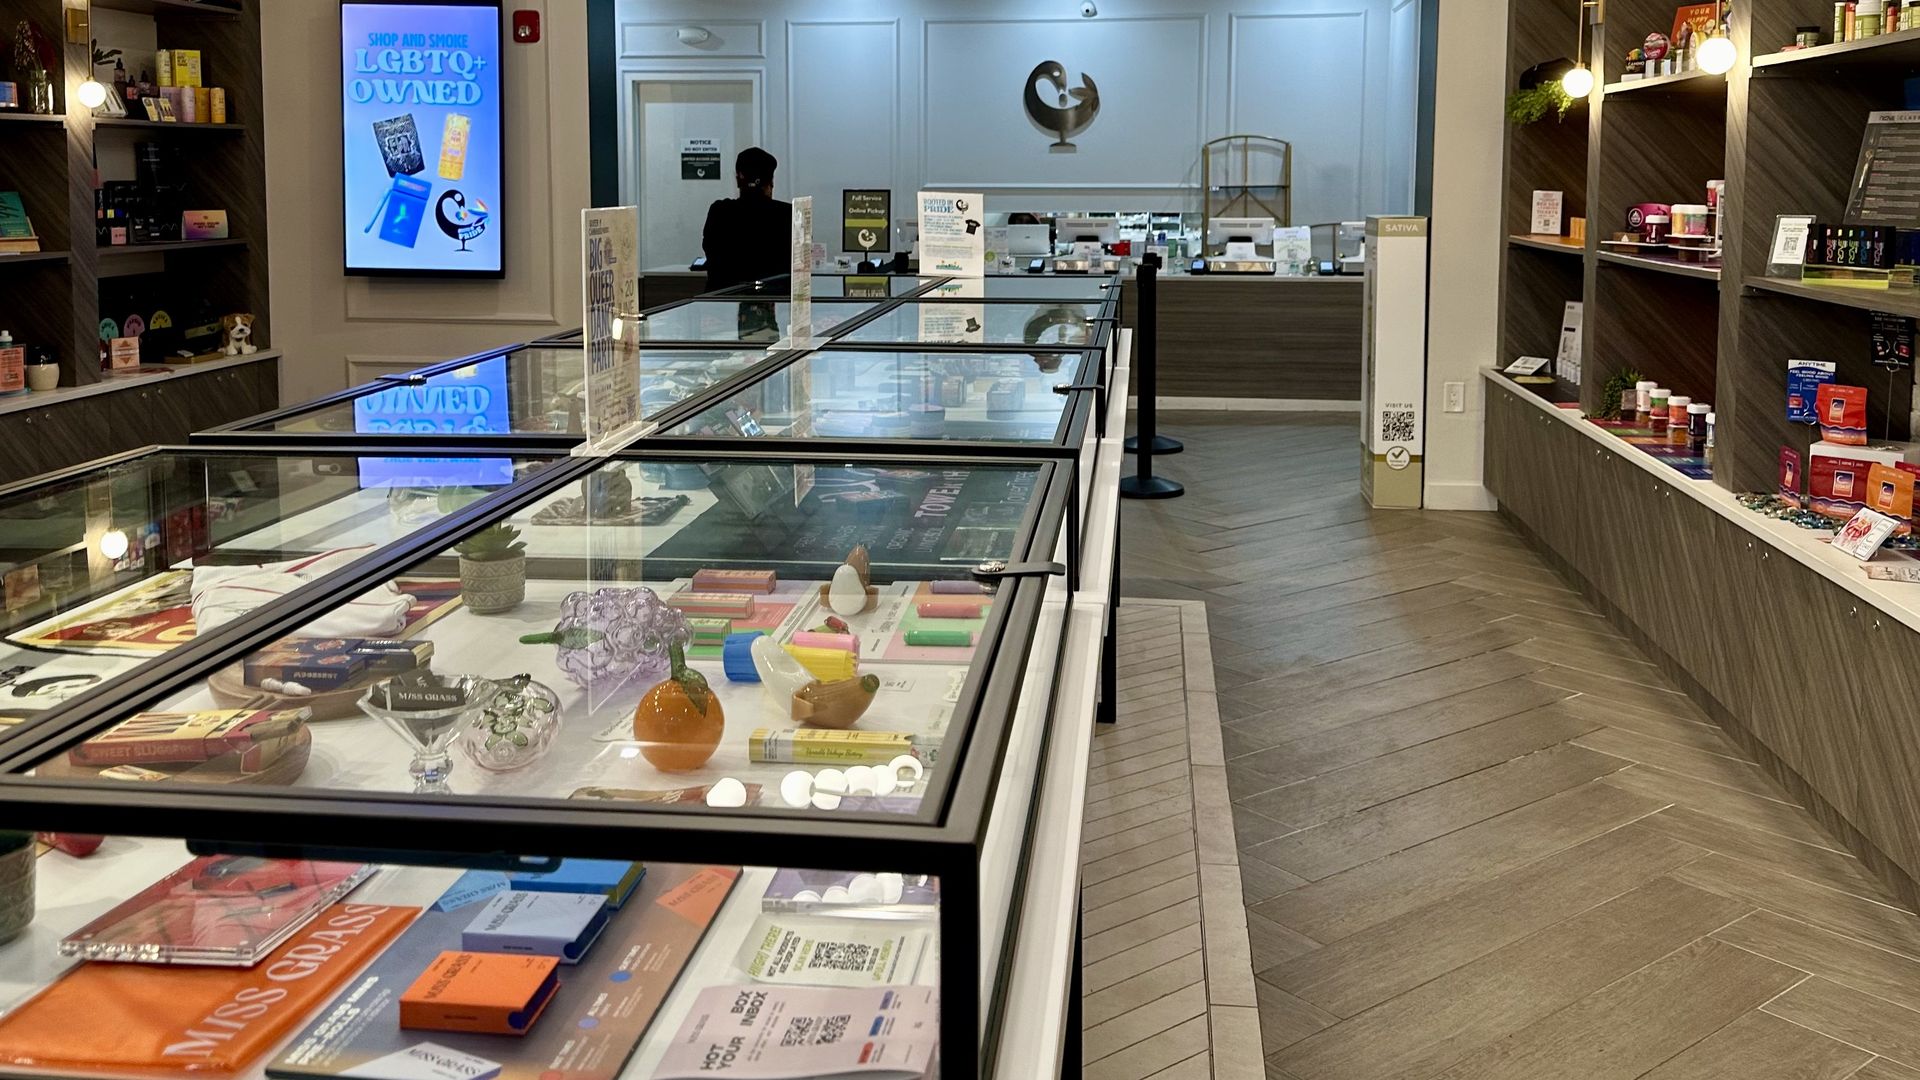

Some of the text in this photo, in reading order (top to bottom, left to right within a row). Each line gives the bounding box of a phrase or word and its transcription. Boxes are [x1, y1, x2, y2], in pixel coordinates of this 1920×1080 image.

[1690, 7, 1710, 15] YOUR
[368, 32, 468, 48] SHOP AND SMOKE
[355, 48, 487, 80] LGBTQ+
[349, 78, 482, 105] OWNED
[924, 205, 954, 214] PRIDE
[458, 226, 484, 240] PRIDE
[1385, 224, 1418, 232] SATIVA
[589, 238, 603, 272] BIG
[590, 270, 615, 305] QUEER
[625, 279, 634, 297] 20
[592, 338, 615, 374] PARTY
[398, 692, 458, 702] MISS GRASS
[162, 986, 288, 1058] MISS
[265, 904, 391, 982] GRASS
[700, 1043, 724, 1071] HOT
[730, 990, 754, 1014] BOX
[716, 1036, 746, 1071] YOUR
[740, 991, 769, 1027] INBOX
